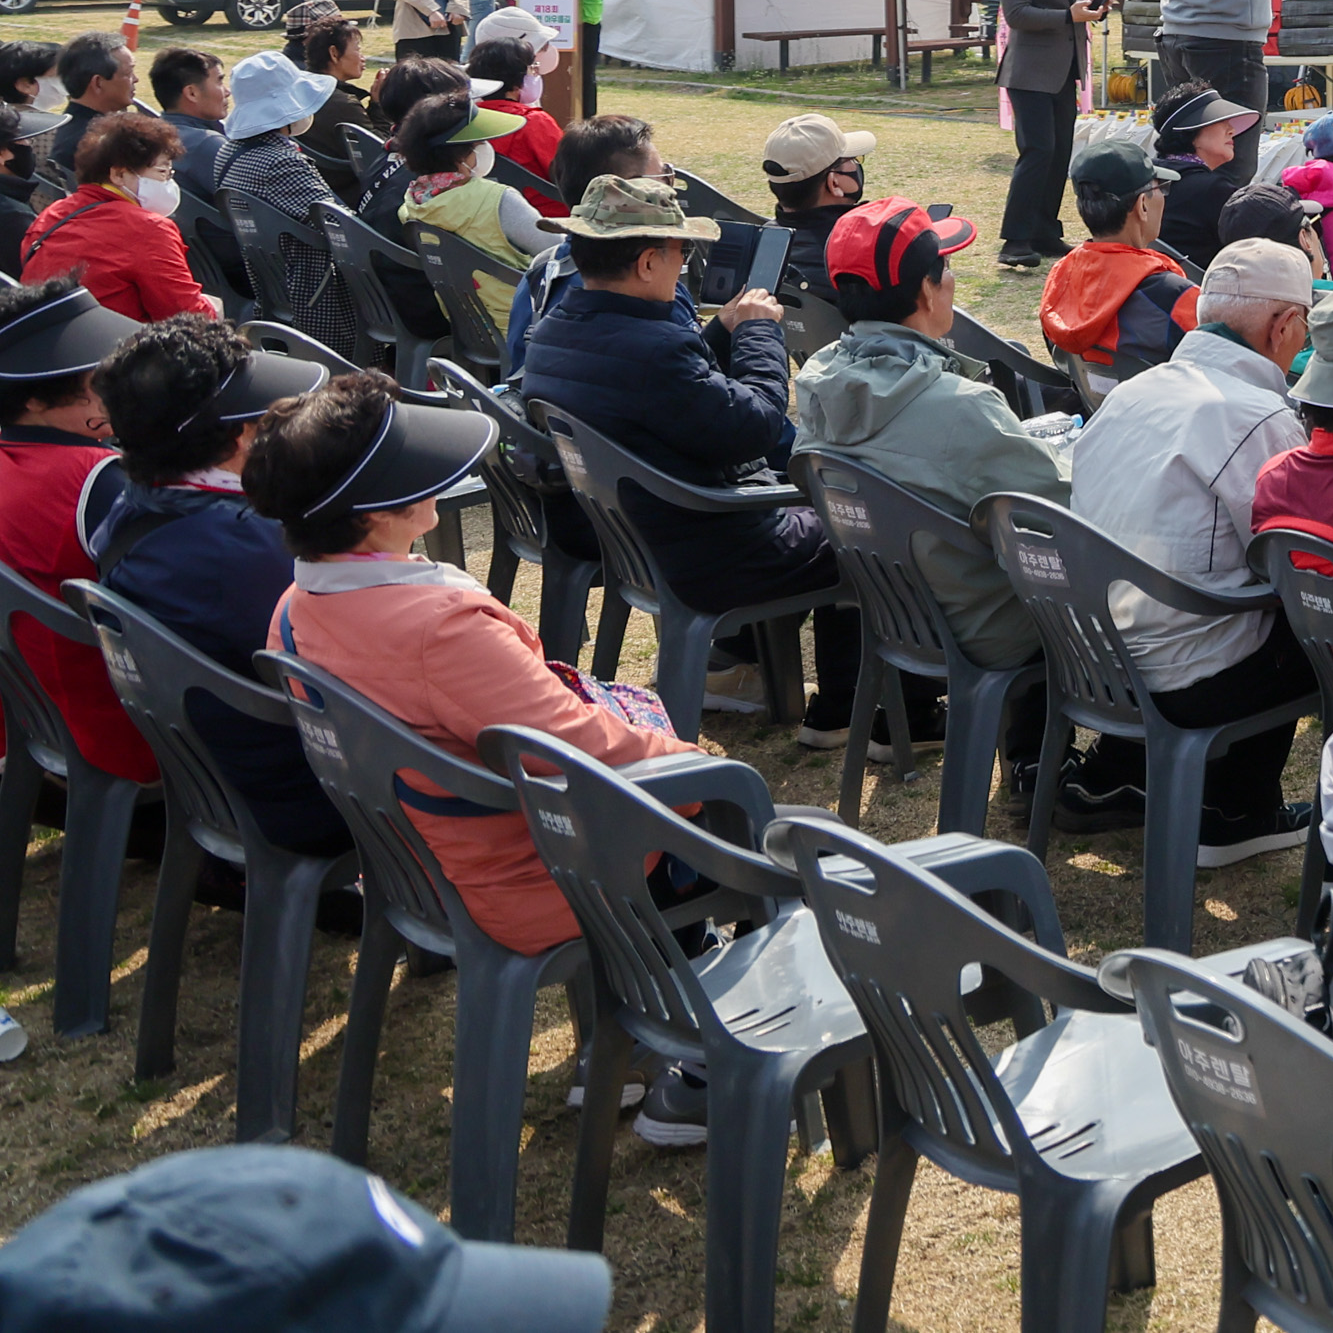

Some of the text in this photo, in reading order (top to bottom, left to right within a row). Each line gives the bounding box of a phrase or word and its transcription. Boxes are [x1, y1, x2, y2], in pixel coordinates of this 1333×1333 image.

[534, 4, 559, 14] 제18회
[544, 14, 571, 24] 아우름길
[828, 501, 867, 521] 아주렌탈
[1018, 550, 1061, 571] 아주렌탈
[1177, 1038, 1251, 1088] 아주렌탈
